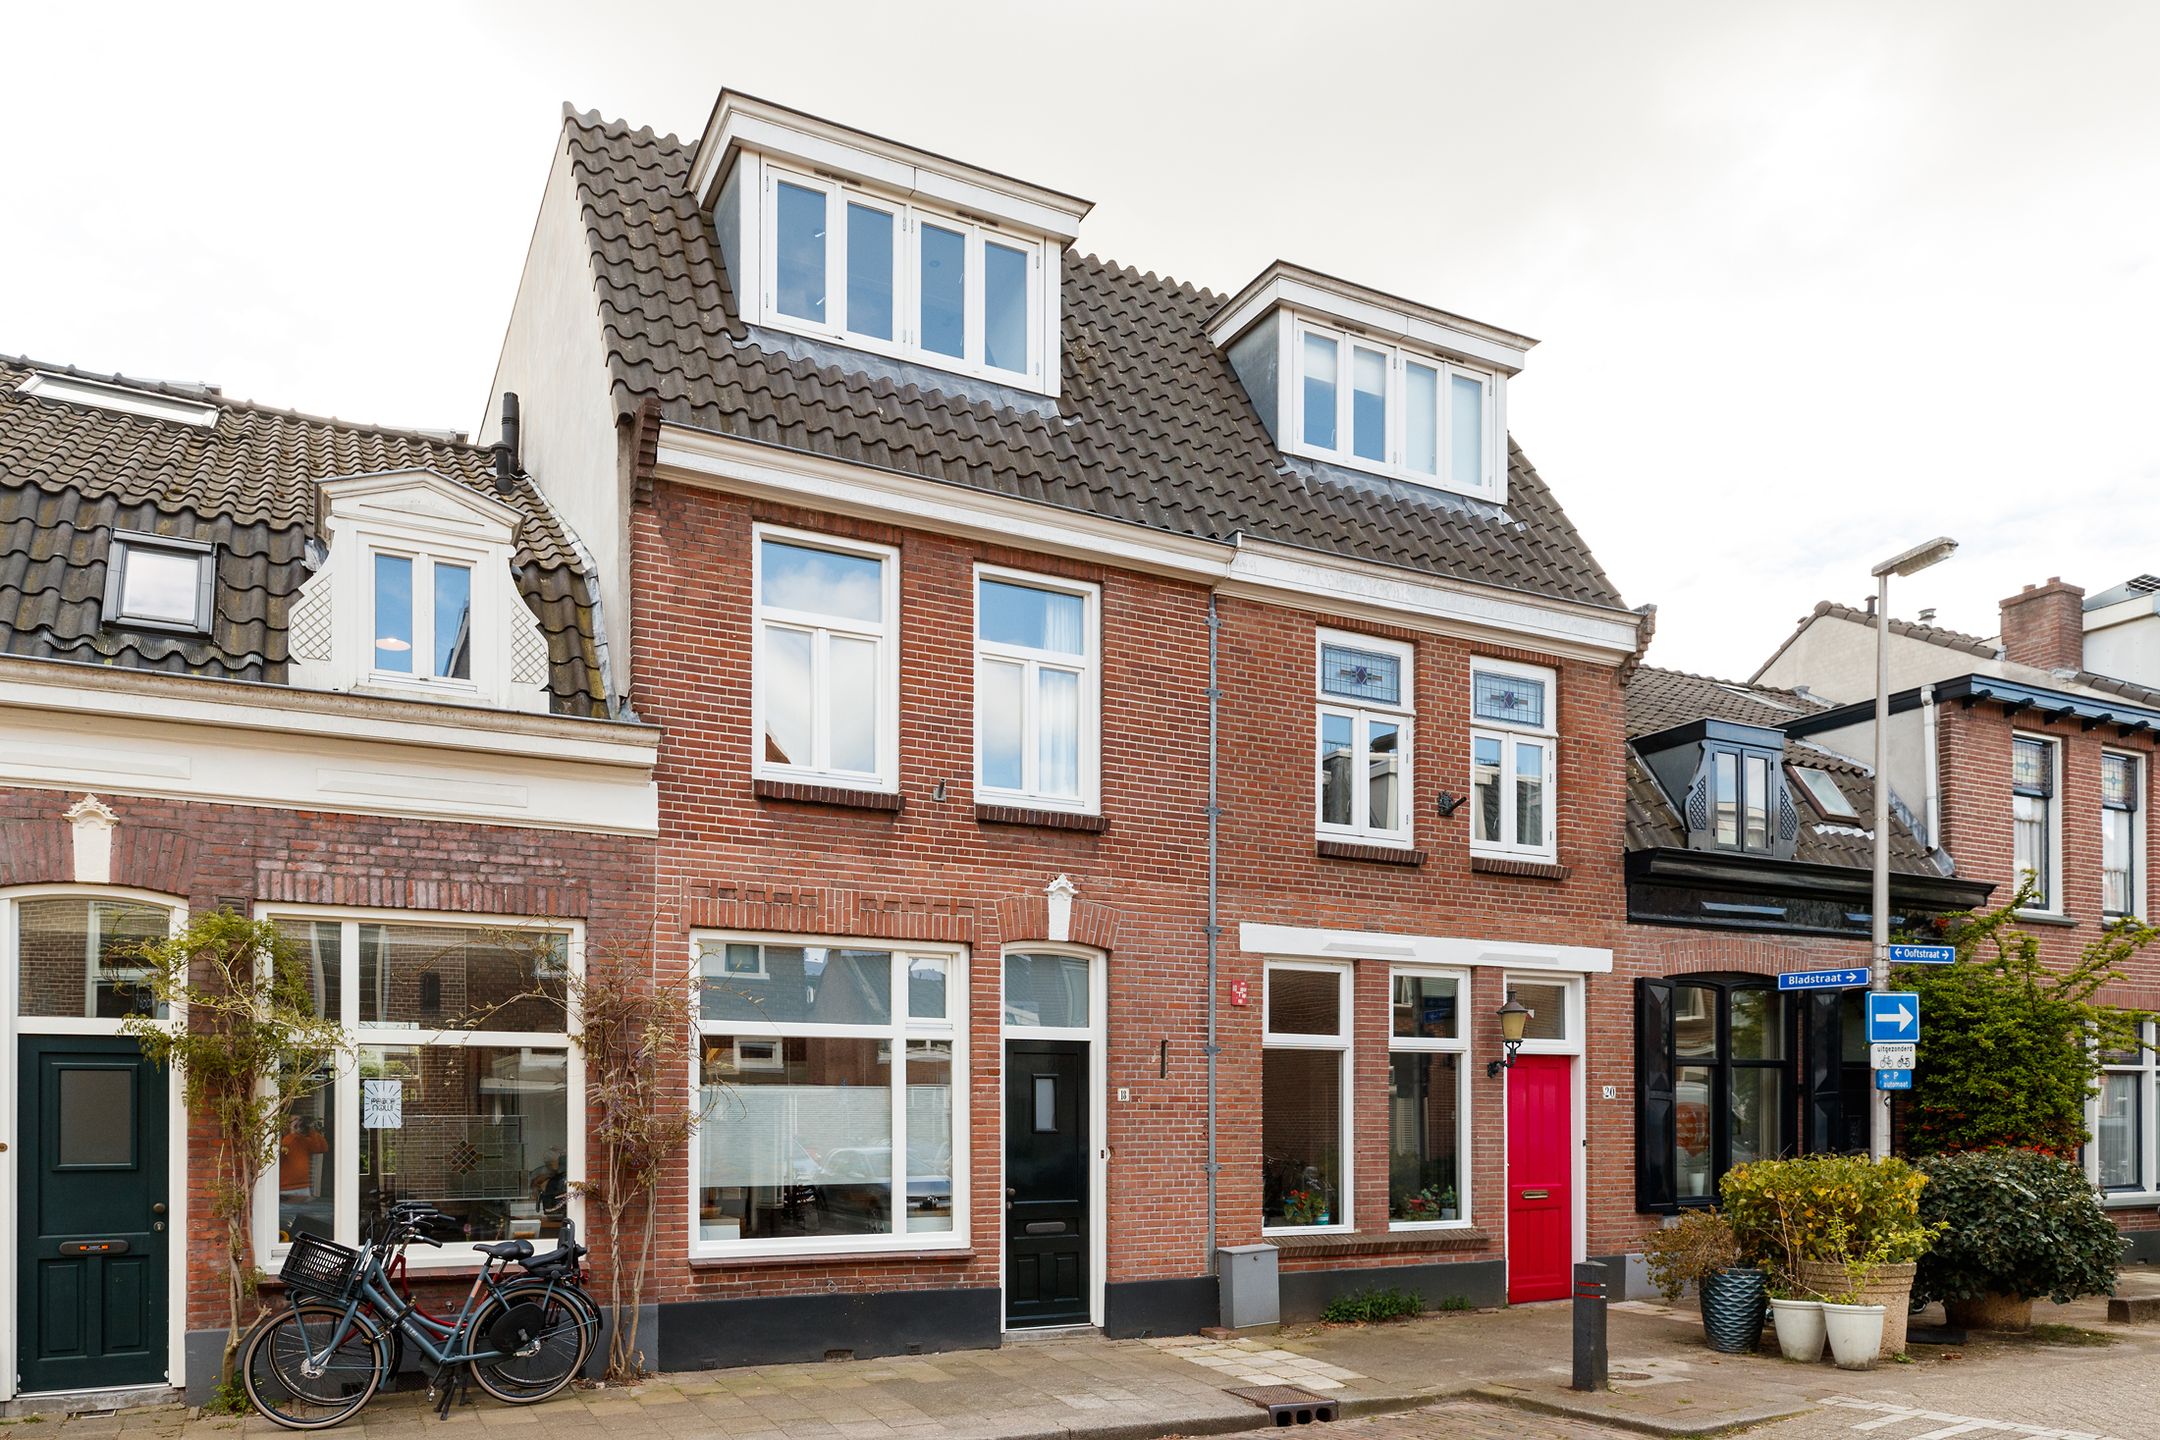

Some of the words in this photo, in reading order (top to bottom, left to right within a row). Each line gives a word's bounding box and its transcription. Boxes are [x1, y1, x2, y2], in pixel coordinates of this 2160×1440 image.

[1904, 949, 1940, 959] Ooftstraat
[1788, 974, 1841, 985] Bladstraat
[1893, 1071, 1899, 1080] P
[1605, 1086, 1615, 1098] 20
